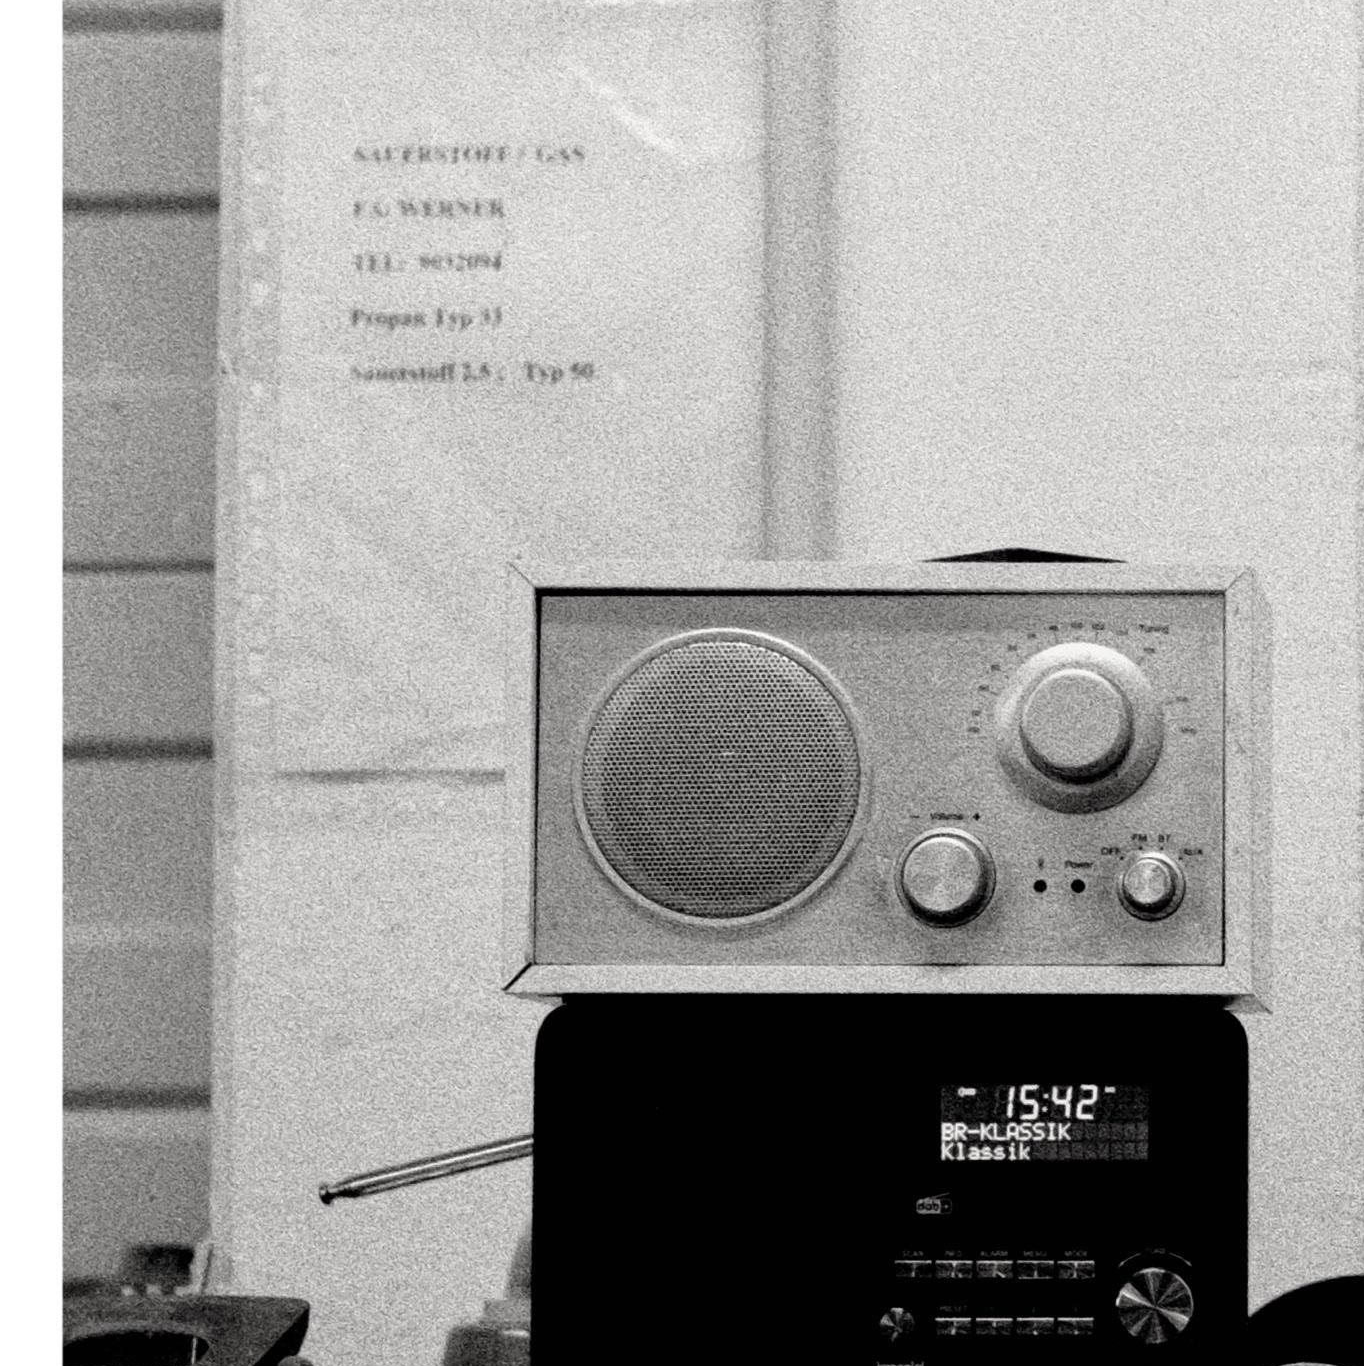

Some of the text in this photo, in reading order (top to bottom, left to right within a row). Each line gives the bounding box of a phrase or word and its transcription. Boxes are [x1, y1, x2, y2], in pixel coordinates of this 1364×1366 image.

[353, 145, 508, 164] SAUERSTOFF
[535, 145, 586, 164] GAS
[398, 198, 506, 219] WERNER
[350, 307, 427, 332] Propan
[435, 307, 474, 333] Typ
[350, 362, 457, 383] Sauerstoff
[525, 361, 565, 385] Typ
[1064, 859, 1094, 870] Power
[1006, 1083, 1099, 1121] 15:42
[940, 1122, 1073, 1142] BR-KLASSIK
[940, 1142, 1031, 1162] Klassik
